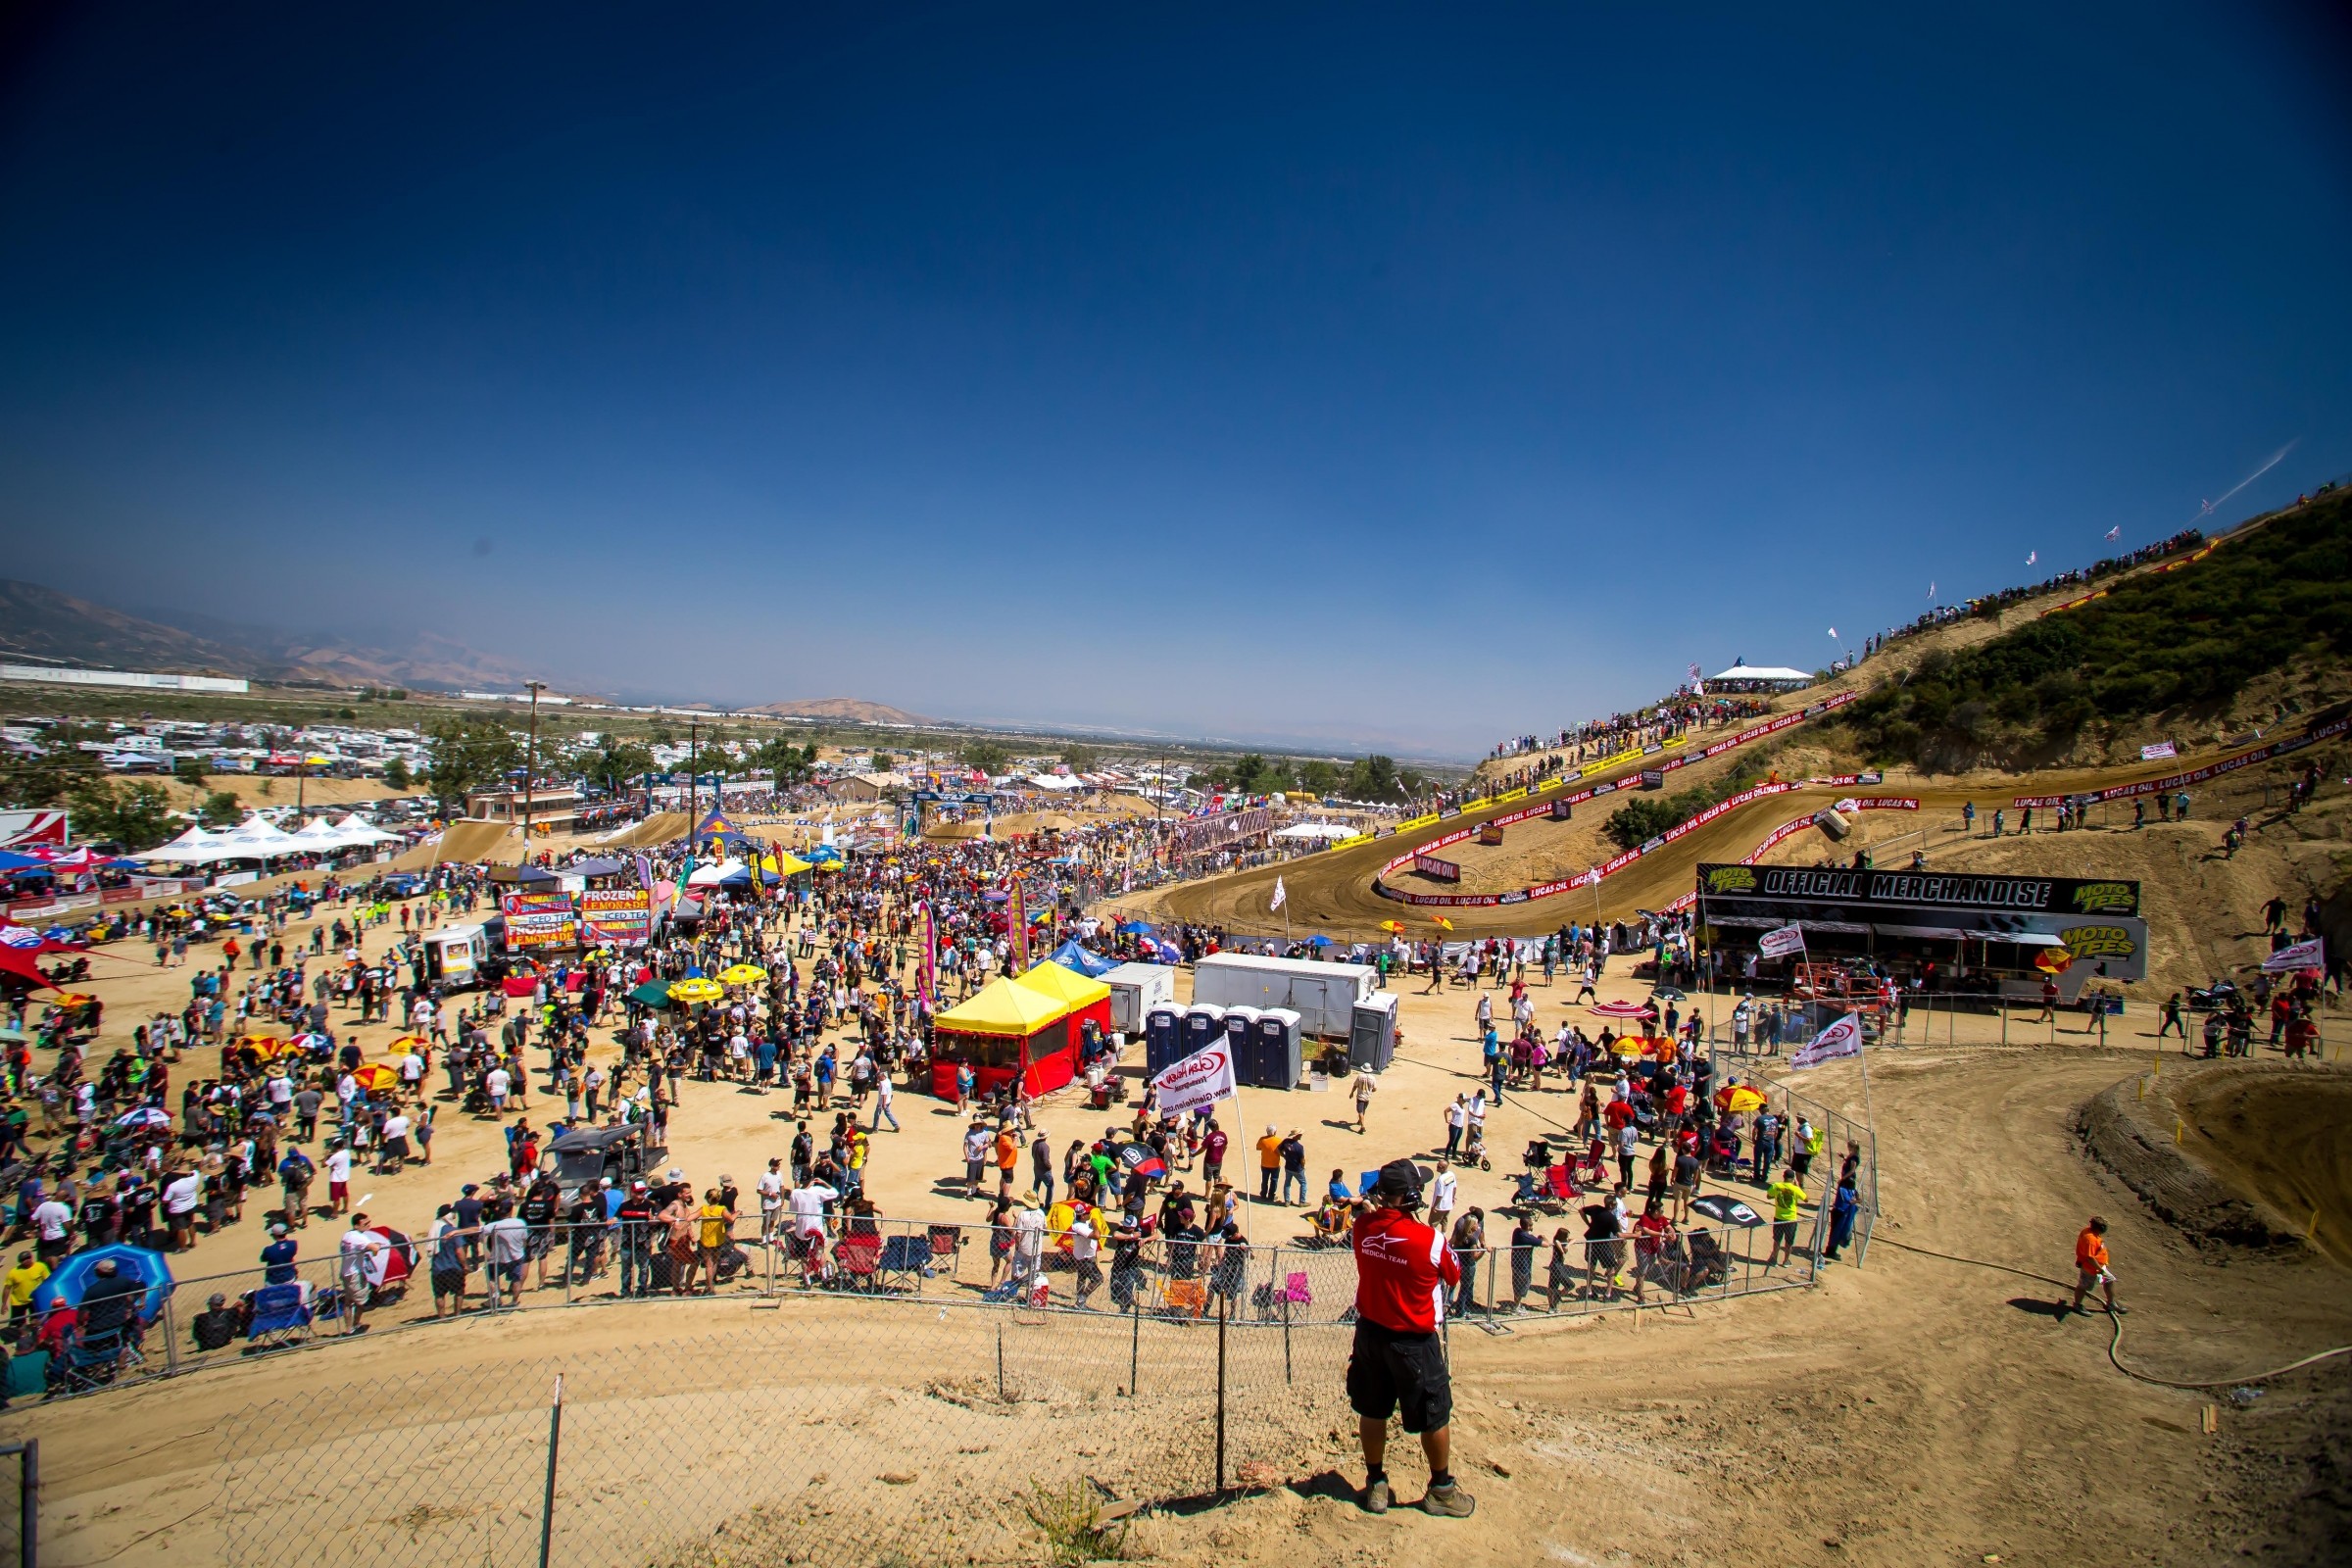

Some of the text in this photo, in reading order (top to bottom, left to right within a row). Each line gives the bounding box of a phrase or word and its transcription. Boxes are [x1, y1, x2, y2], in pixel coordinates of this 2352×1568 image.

[1827, 691, 1857, 708] LUCAS OIL
[1772, 712, 1802, 729] LUCAS OIL
[1740, 725, 1770, 742] LUCAS OIL
[2313, 720, 2348, 741] LUCAS
[1707, 738, 1738, 756] LUCAS OIL
[2215, 749, 2269, 773] LUCAS OIL
[1618, 776, 1638, 788] LUCAS
[2159, 769, 2211, 789] LUCAS OIL
[2104, 786, 2135, 800] LUCAS
[2137, 783, 2154, 792] OIL
[1527, 805, 1545, 816] LUCAS
[1878, 799, 1917, 808] LUCAS OIL
[2014, 797, 2060, 808] LUCAS OIL
[1494, 811, 1524, 826] LUCAS OIL
[1699, 802, 1730, 823] LUCAS OIL
[1442, 833, 1459, 845] LUCAS
[1460, 829, 1470, 838] OIL
[1666, 818, 1697, 842] LUCAS OIL
[1418, 857, 1455, 879] LUCAS OIL
[1607, 850, 1640, 872] LUCAS OIL
[1708, 866, 1752, 886] MOTO
[1531, 884, 1555, 898] LUCAS
[1555, 880, 1568, 892] OIL
[1715, 876, 1757, 894] TEES
[1765, 869, 2052, 907] OFFICIAL MERCHANDISE
[2073, 883, 2130, 904] MOTO
[583, 890, 636, 902] FROZEN
[1415, 896, 1452, 906] LUCAS OIL
[1455, 897, 1481, 906] LUCAS
[1483, 896, 1495, 905] OIL
[2082, 893, 2136, 912] TEES
[583, 901, 648, 910] LEMONADE
[529, 912, 574, 923] ICED TEA
[509, 922, 563, 936] FROZEN
[2061, 925, 2129, 945] MOTO
[509, 932, 574, 945] LEMONADE
[2072, 939, 2137, 961] TEES
[1361, 1248, 1408, 1266] MEDICAL TEAM
